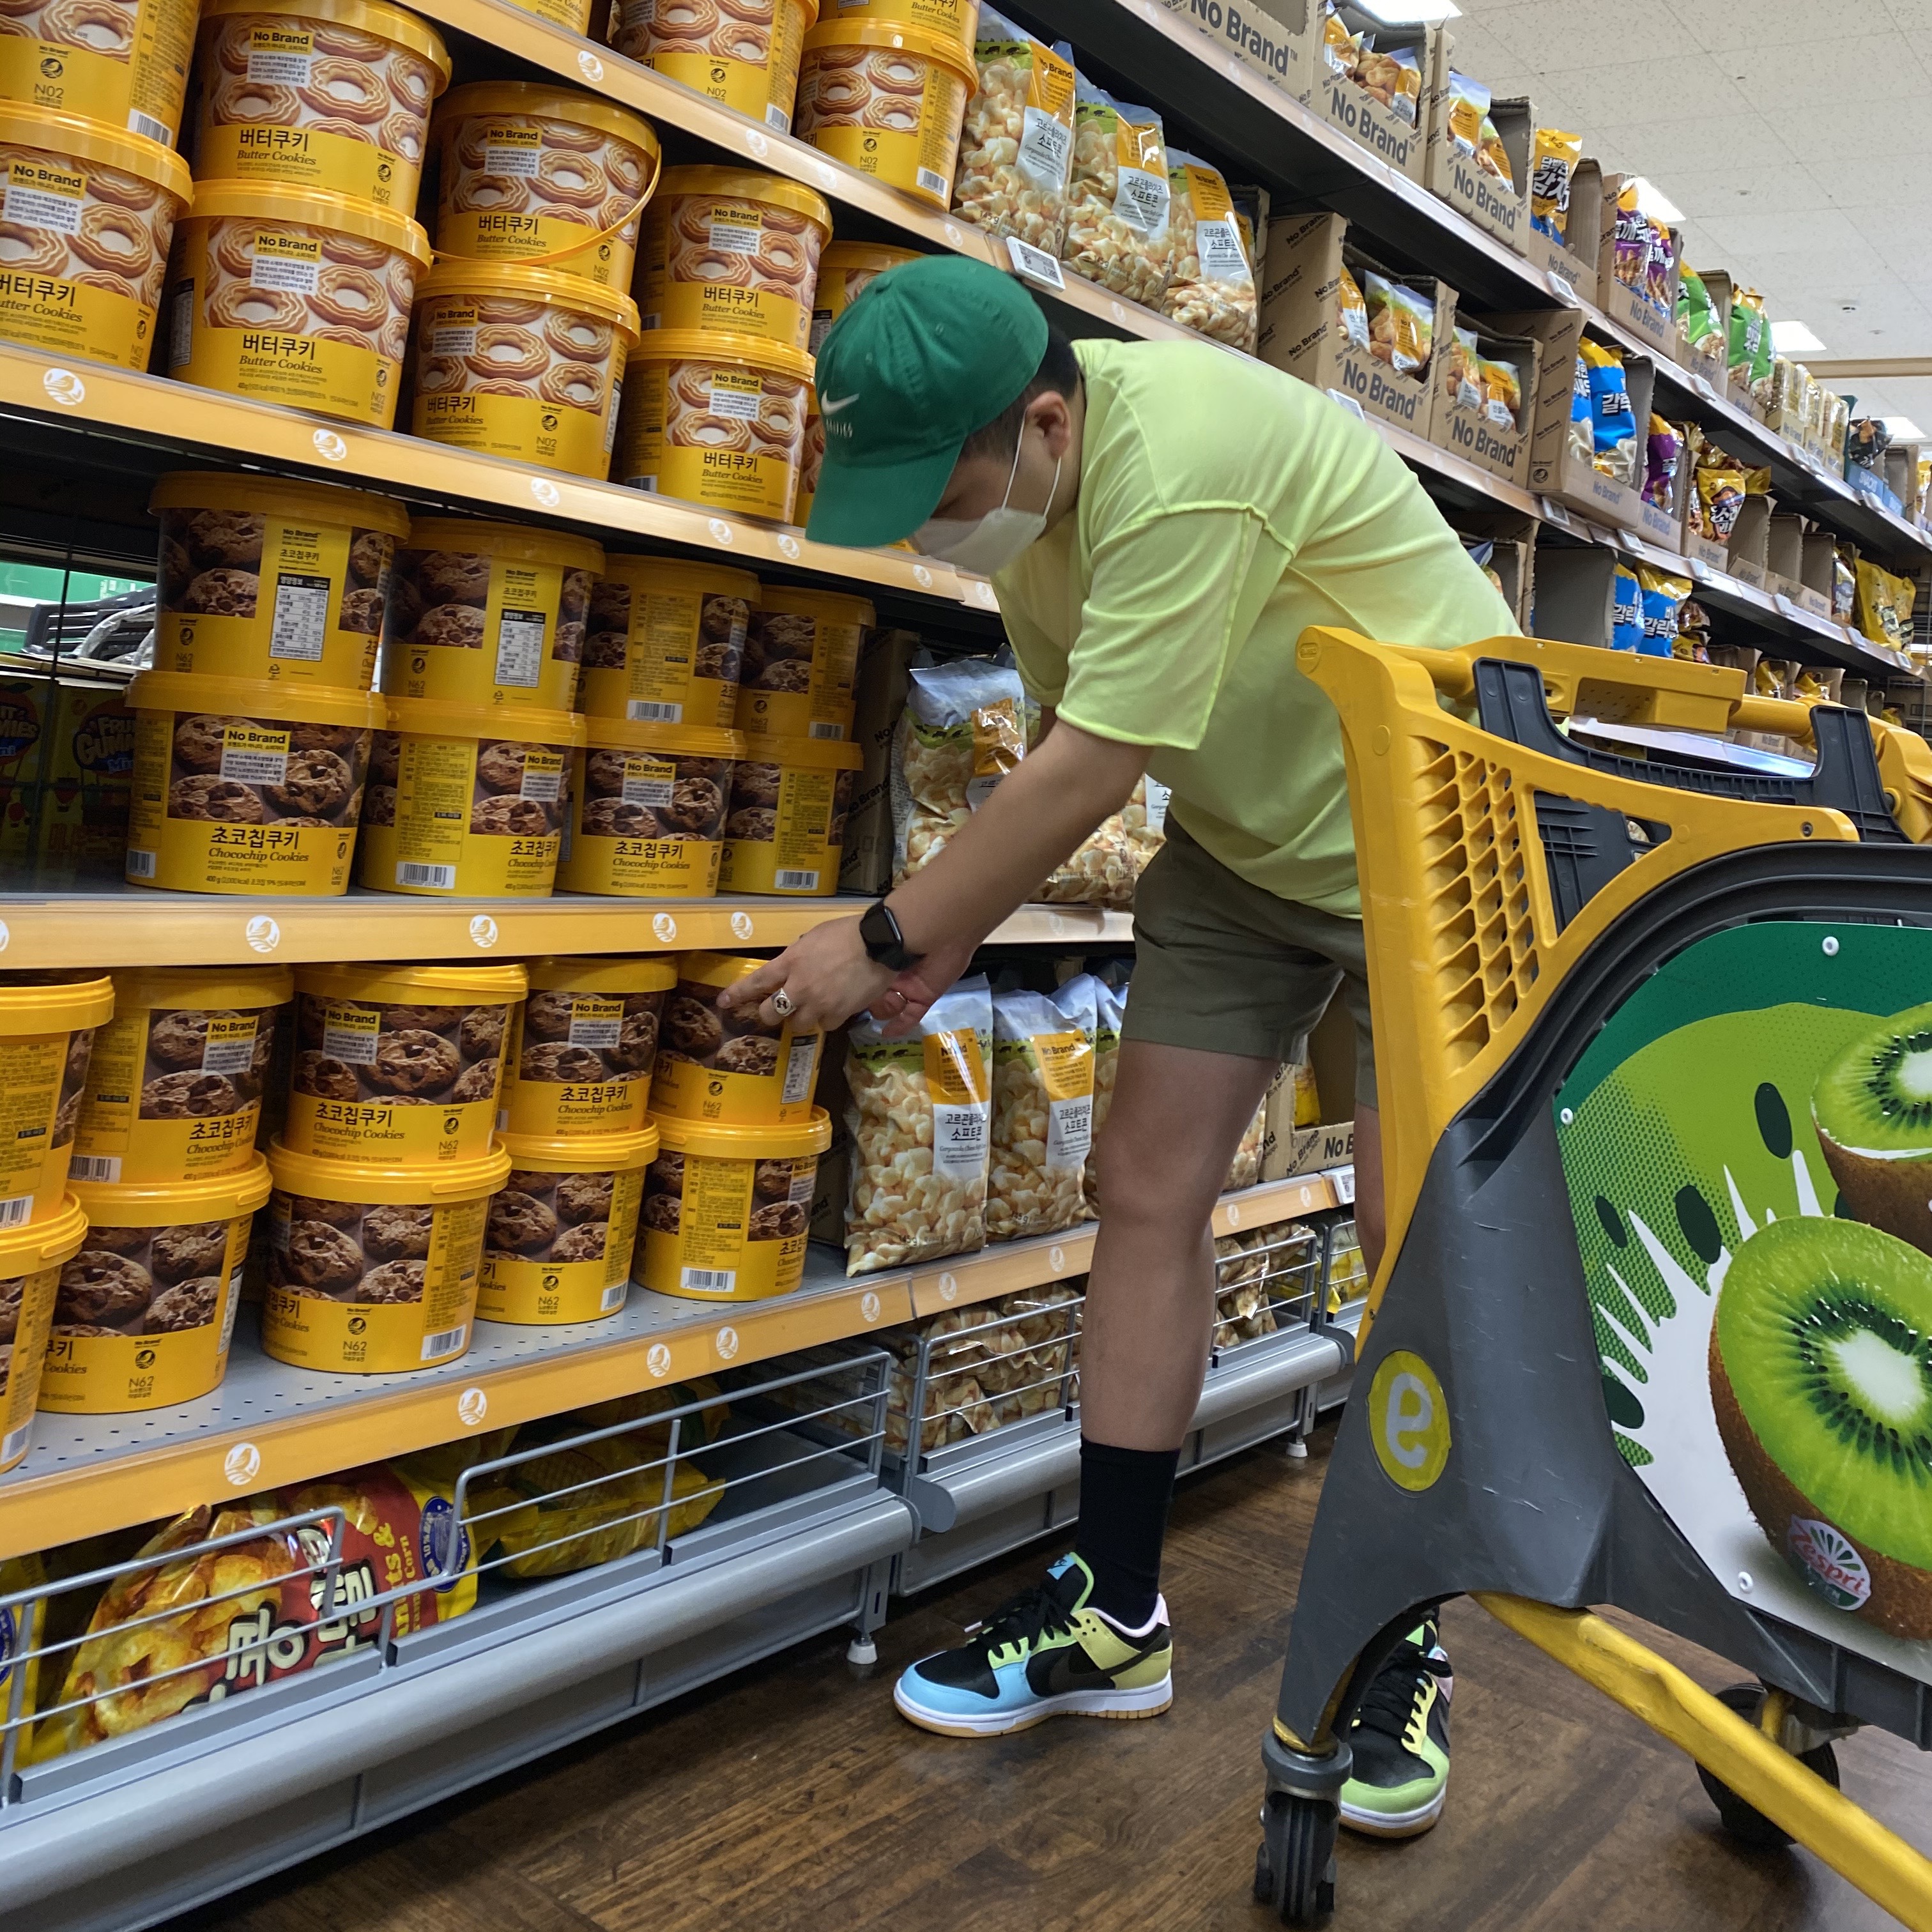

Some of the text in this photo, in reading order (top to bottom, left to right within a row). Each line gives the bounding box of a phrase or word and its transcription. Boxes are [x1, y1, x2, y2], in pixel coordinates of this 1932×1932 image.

[912, 2, 935, 13] Butter
[937, 9, 960, 23] Cookies
[254, 31, 309, 45] No Brand
[1191, 0, 1289, 77] No Brand
[34, 83, 64, 99] N02
[707, 86, 726, 98] N02
[490, 130, 538, 140] No Brand
[1331, 87, 1408, 167] No Brand
[240, 129, 309, 151] 버터쿠키
[237, 150, 317, 165] Butter Cookies
[860, 156, 878, 165] N02
[14, 164, 82, 188] No Brand
[1131, 190, 1158, 208] 소프트콘
[1454, 164, 1515, 231] No Brand
[715, 209, 758, 222] No Brand
[479, 217, 539, 234] 버터쿠키
[1299, 215, 1324, 234] Bran
[259, 236, 317, 252] No Brand
[477, 234, 547, 247] Butter Cookies
[1548, 254, 1577, 284] No Brand
[1262, 268, 1300, 303] No Brand
[1328, 277, 1340, 289] Bra
[703, 287, 759, 307] 버터쿠키
[0, 299, 82, 323] utter Cookies
[436, 309, 475, 319] No Brand
[703, 303, 765, 319] Butter Cookies
[1630, 300, 1665, 337] No Brand
[1289, 322, 1328, 356] No Brand
[243, 335, 316, 360] 버터쿠키
[239, 355, 323, 374] Butter Cookies
[715, 374, 759, 387] No Brand
[1343, 359, 1416, 420] No Brand
[427, 396, 475, 413] 버터쿠키
[448, 415, 484, 425] Cookies
[1452, 416, 1515, 468] No Brand
[703, 452, 757, 472] 버터쿠키
[702, 470, 763, 484] Butter Cookies
[1593, 481, 1621, 505] No Brand
[1643, 505, 1670, 534] No Brand
[228, 731, 286, 744] No Brand
[528, 756, 561, 765] No Brand
[627, 763, 672, 774] No Brand
[211, 827, 300, 849] 초코칩쿠키
[208, 848, 309, 863] Chocochip Cookies
[615, 841, 682, 858] 초코칩쿠키
[613, 858, 690, 870] Chocochip Cookies
[576, 1003, 621, 1012] No Brand
[328, 1010, 376, 1024] No Brand
[211, 1021, 256, 1032] No Brand
[1041, 1043, 1076, 1055] No Brand
[560, 1085, 628, 1103] 초코칩쿠키
[316, 1103, 392, 1127] 초코칩쿠키
[558, 1102, 633, 1116] Chocochip Cookies
[190, 1116, 253, 1140] 초코칩쿠키
[314, 1123, 405, 1140] Chocochip Cookies
[951, 1126, 982, 1141] 소프트콘
[1064, 1119, 1087, 1135] 소프트콘
[439, 1140, 459, 1150] N62
[1324, 1137, 1344, 1159] No
[538, 1297, 559, 1305] N62
[343, 1341, 367, 1351] N62
[129, 1376, 155, 1387] N62
